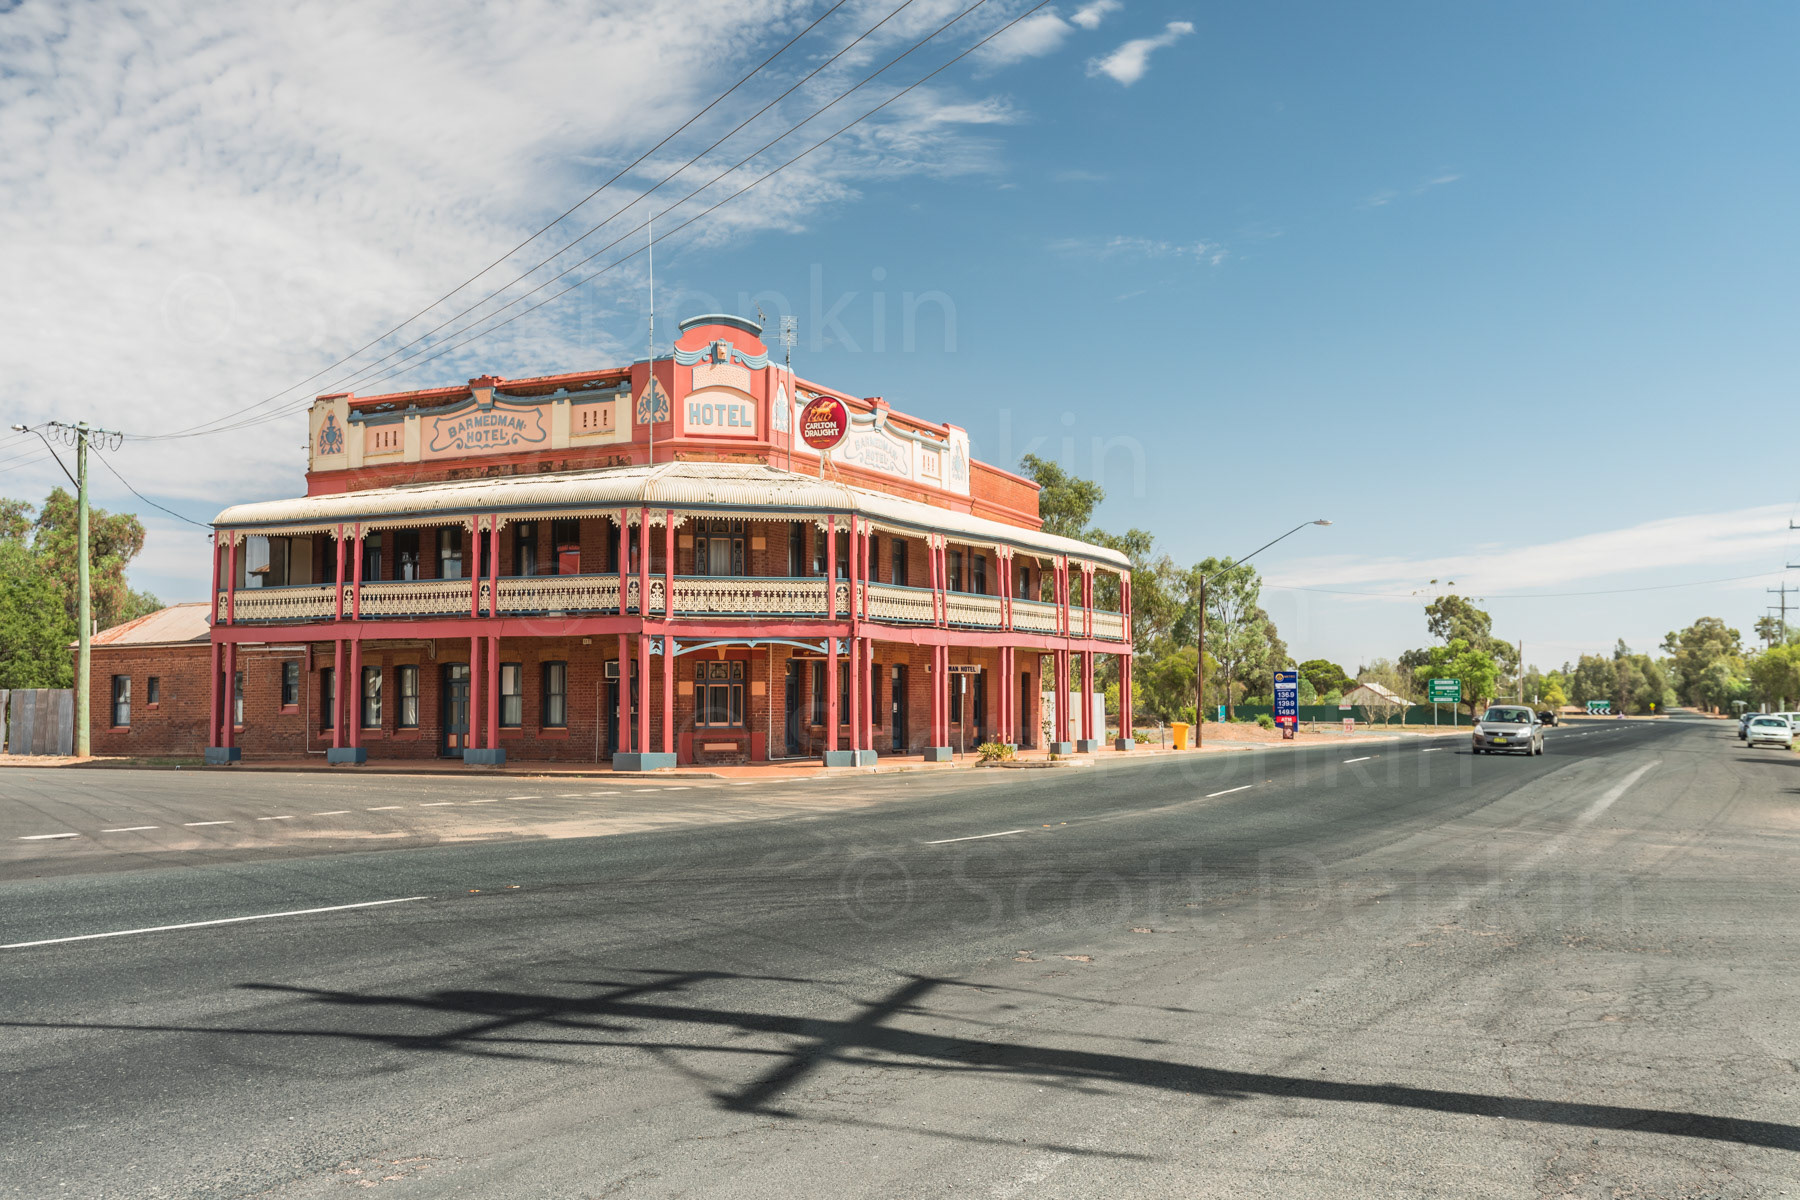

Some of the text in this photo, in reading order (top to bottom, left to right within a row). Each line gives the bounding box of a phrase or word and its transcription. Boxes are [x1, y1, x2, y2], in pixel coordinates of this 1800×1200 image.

[689, 403, 752, 427] HOTEL
[805, 421, 837, 430] CARLTON
[804, 428, 840, 438] DRAUGHT
